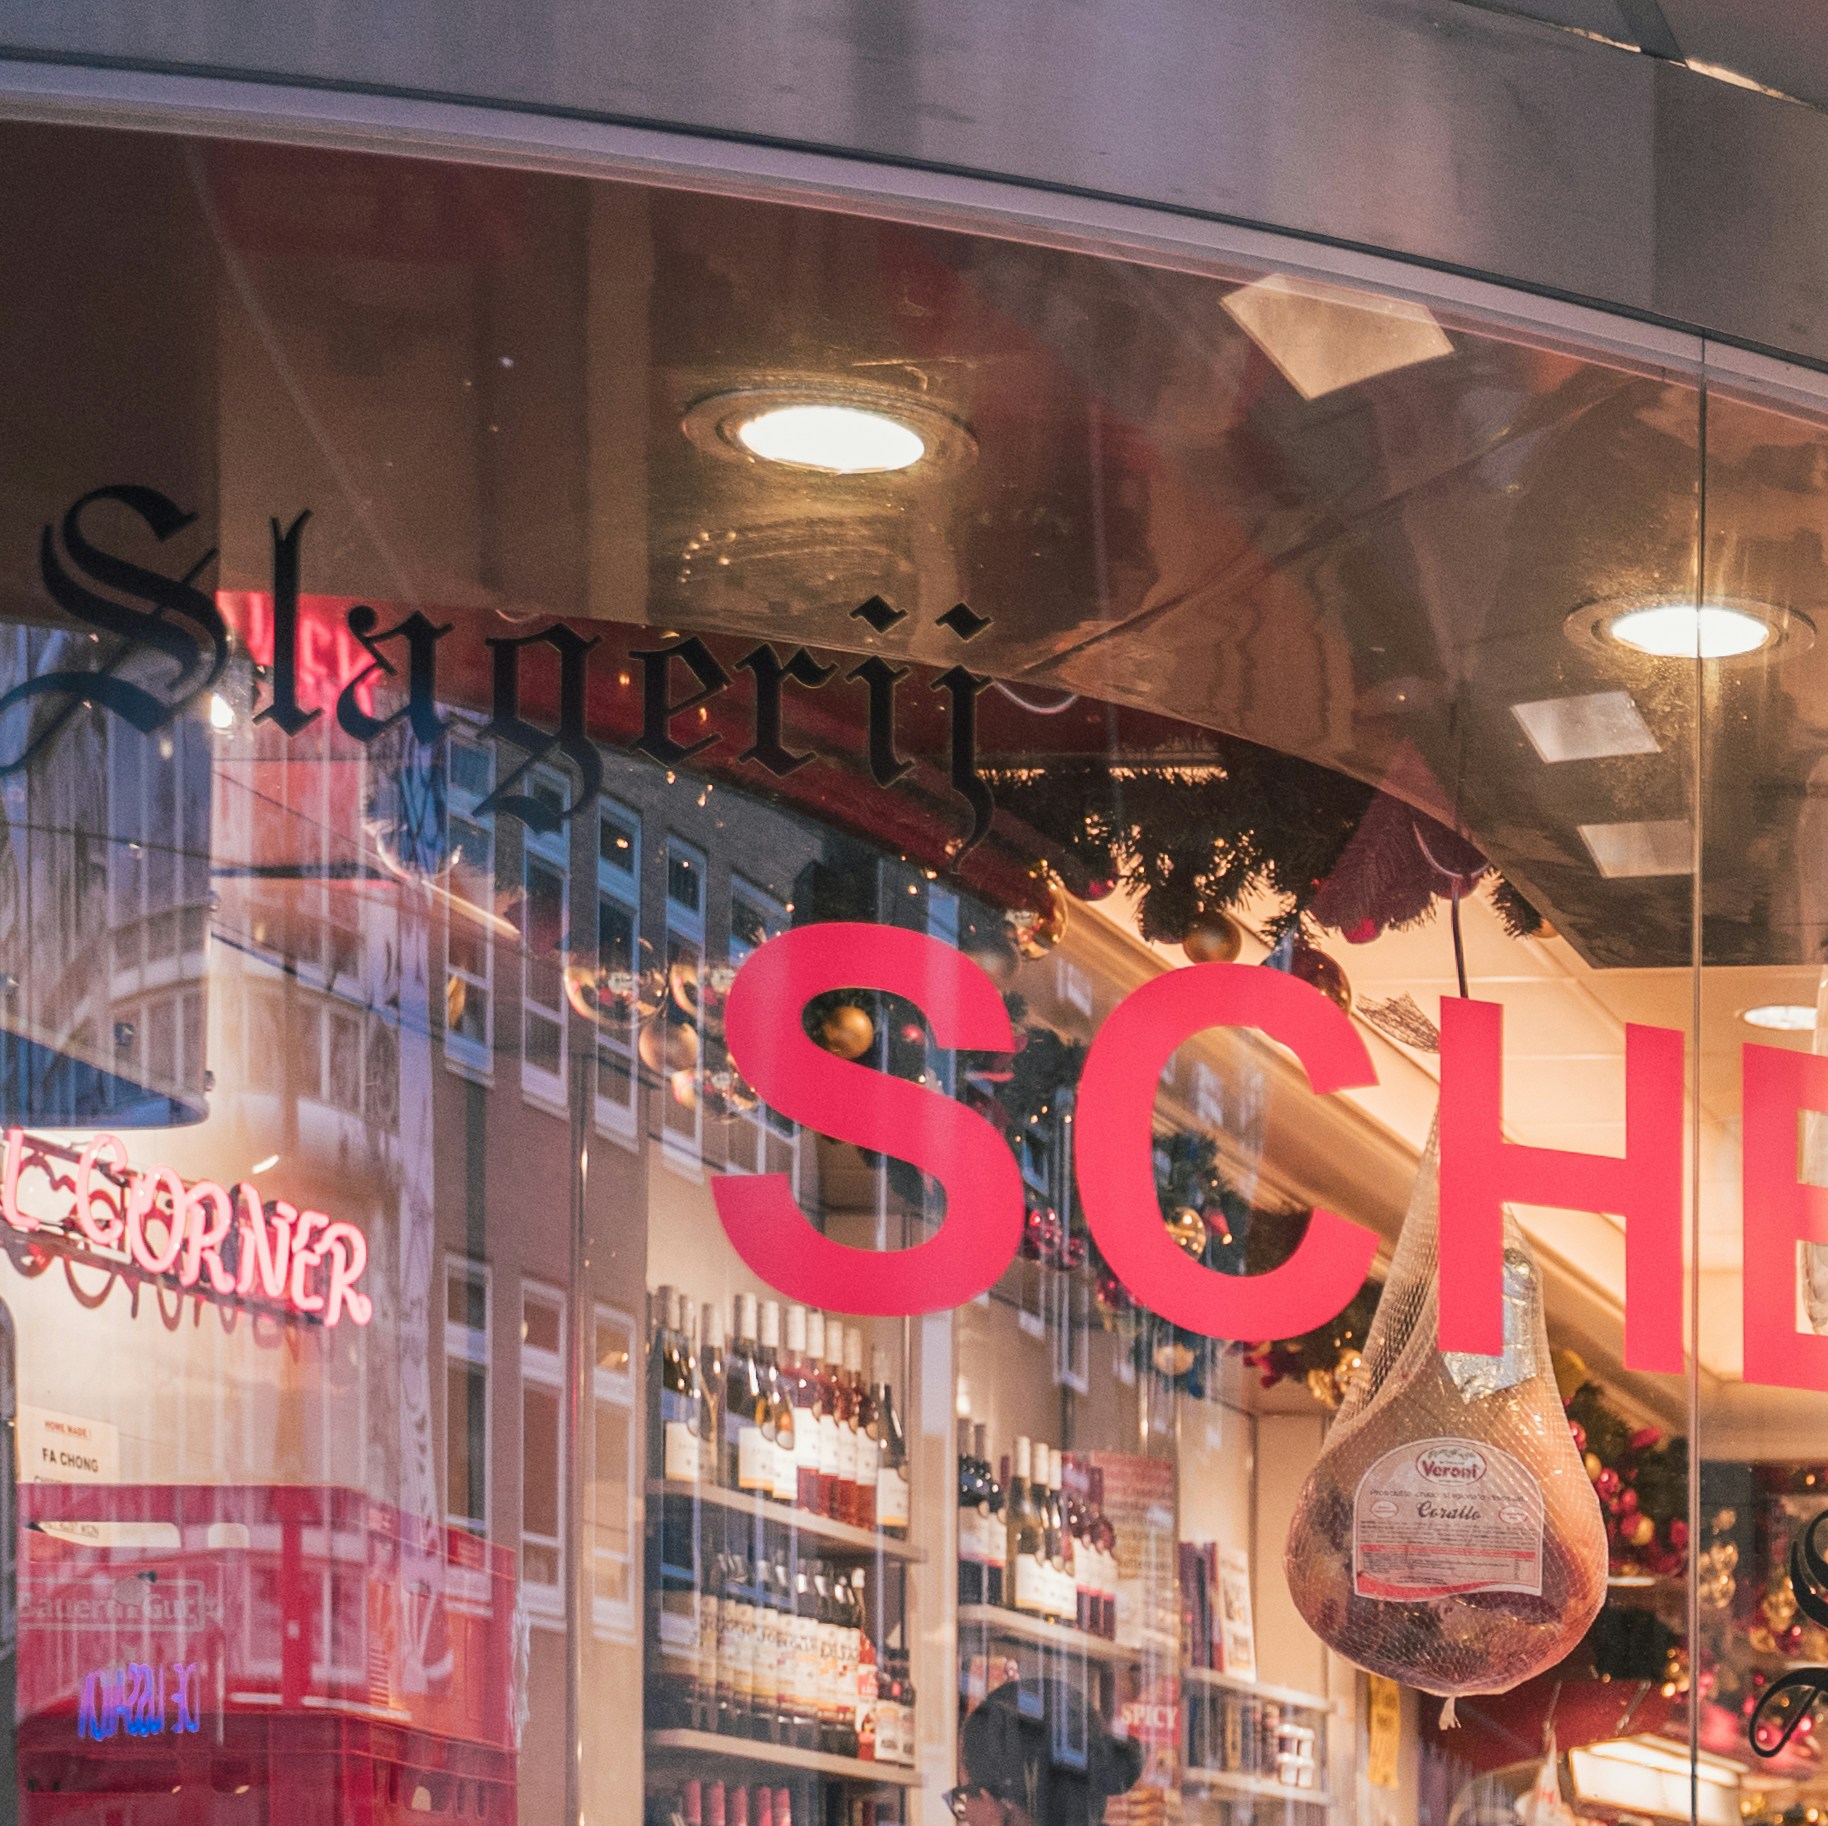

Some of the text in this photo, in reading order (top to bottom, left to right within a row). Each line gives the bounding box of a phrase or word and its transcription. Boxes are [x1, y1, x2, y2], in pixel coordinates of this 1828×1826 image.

[0, 484, 994, 872] Slagerij
[76, 1133, 372, 1327] CORNER
[45, 1420, 66, 1435] HOME
[42, 1448, 98, 1473] FA CHONG
[1422, 1460, 1477, 1479] Veroni
[1119, 1703, 1178, 1729] SPICY
